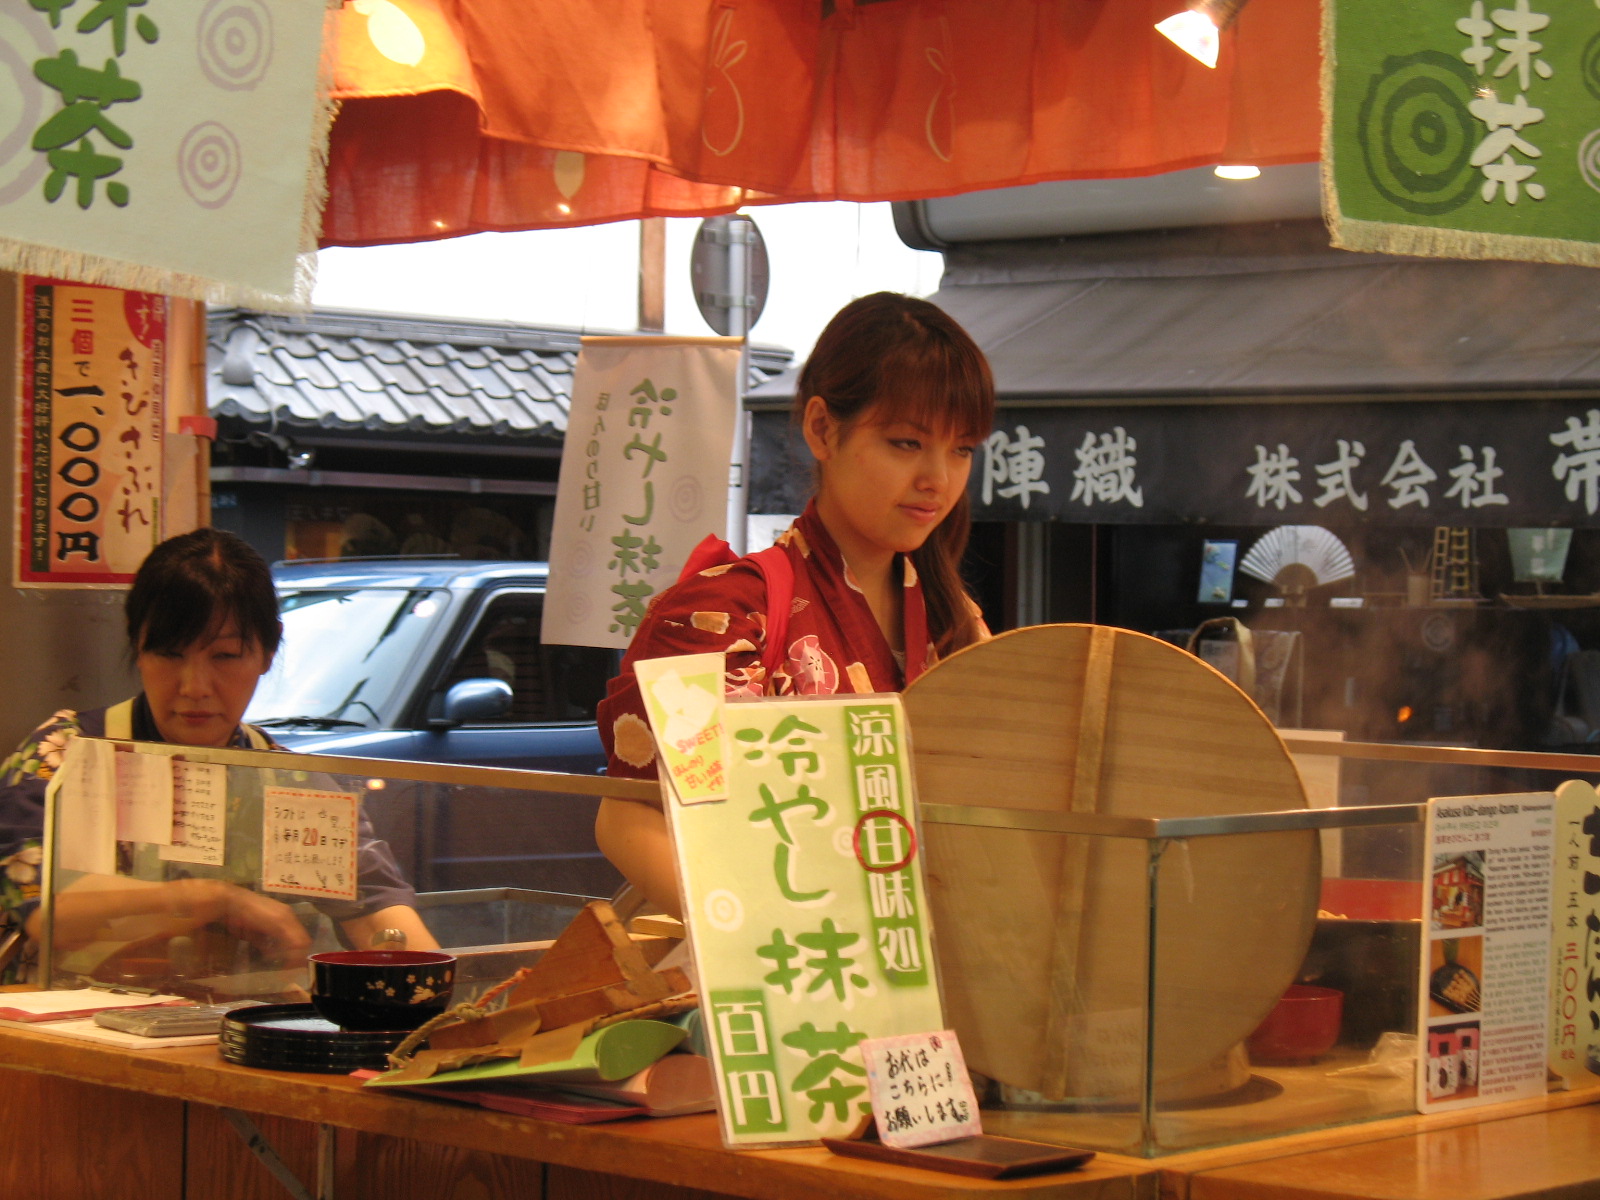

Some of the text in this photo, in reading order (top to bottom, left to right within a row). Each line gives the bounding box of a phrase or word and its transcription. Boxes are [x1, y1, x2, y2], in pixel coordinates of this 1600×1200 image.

[1456, 0, 1553, 205] 抹茶
[977, 424, 1144, 510] 陣織
[1245, 439, 1510, 512] 株式会社
[676, 723, 725, 754] SWEET!
[850, 710, 923, 973] 涼風甘味処
[735, 714, 874, 1125] 冷やし抹茶
[714, 1000, 783, 1127] 百円
[884, 1097, 964, 1133] お願いします
[886, 1047, 930, 1079] お代は
